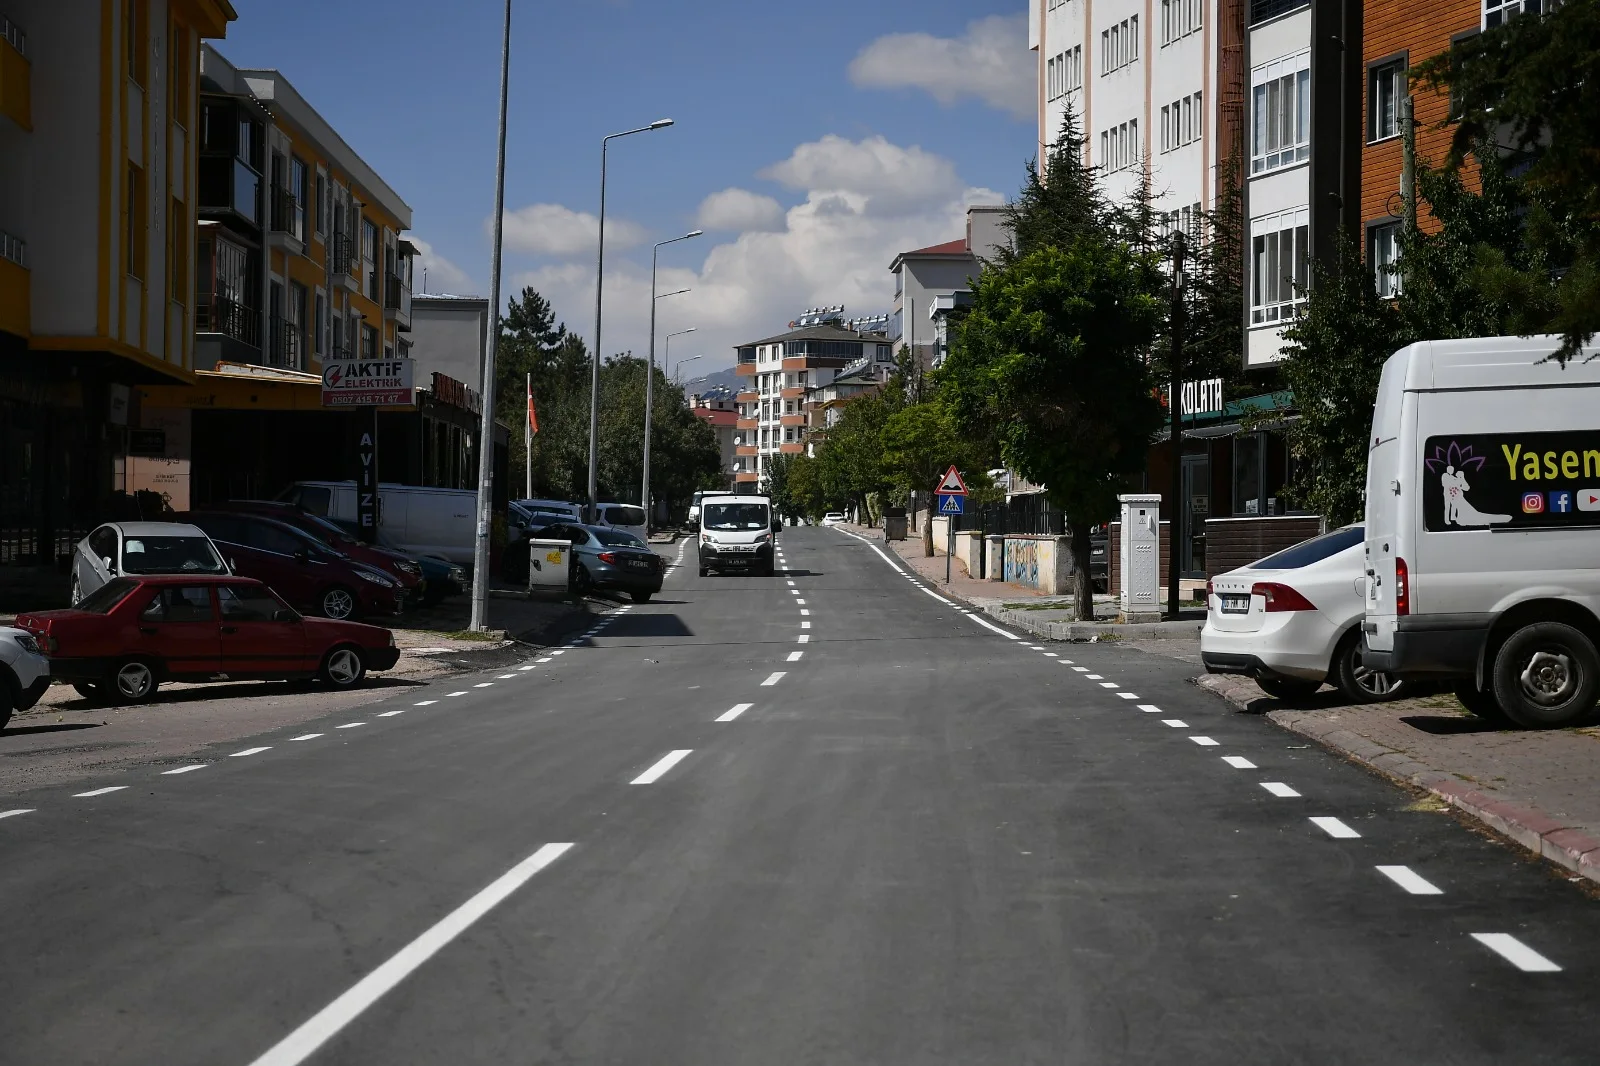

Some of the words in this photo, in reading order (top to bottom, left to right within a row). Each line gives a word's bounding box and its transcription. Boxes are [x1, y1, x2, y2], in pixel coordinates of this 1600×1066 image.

[332, 396, 353, 404] 0507
[356, 396, 372, 404] 415
[374, 395, 385, 403] 71
[387, 394, 399, 403] 47
